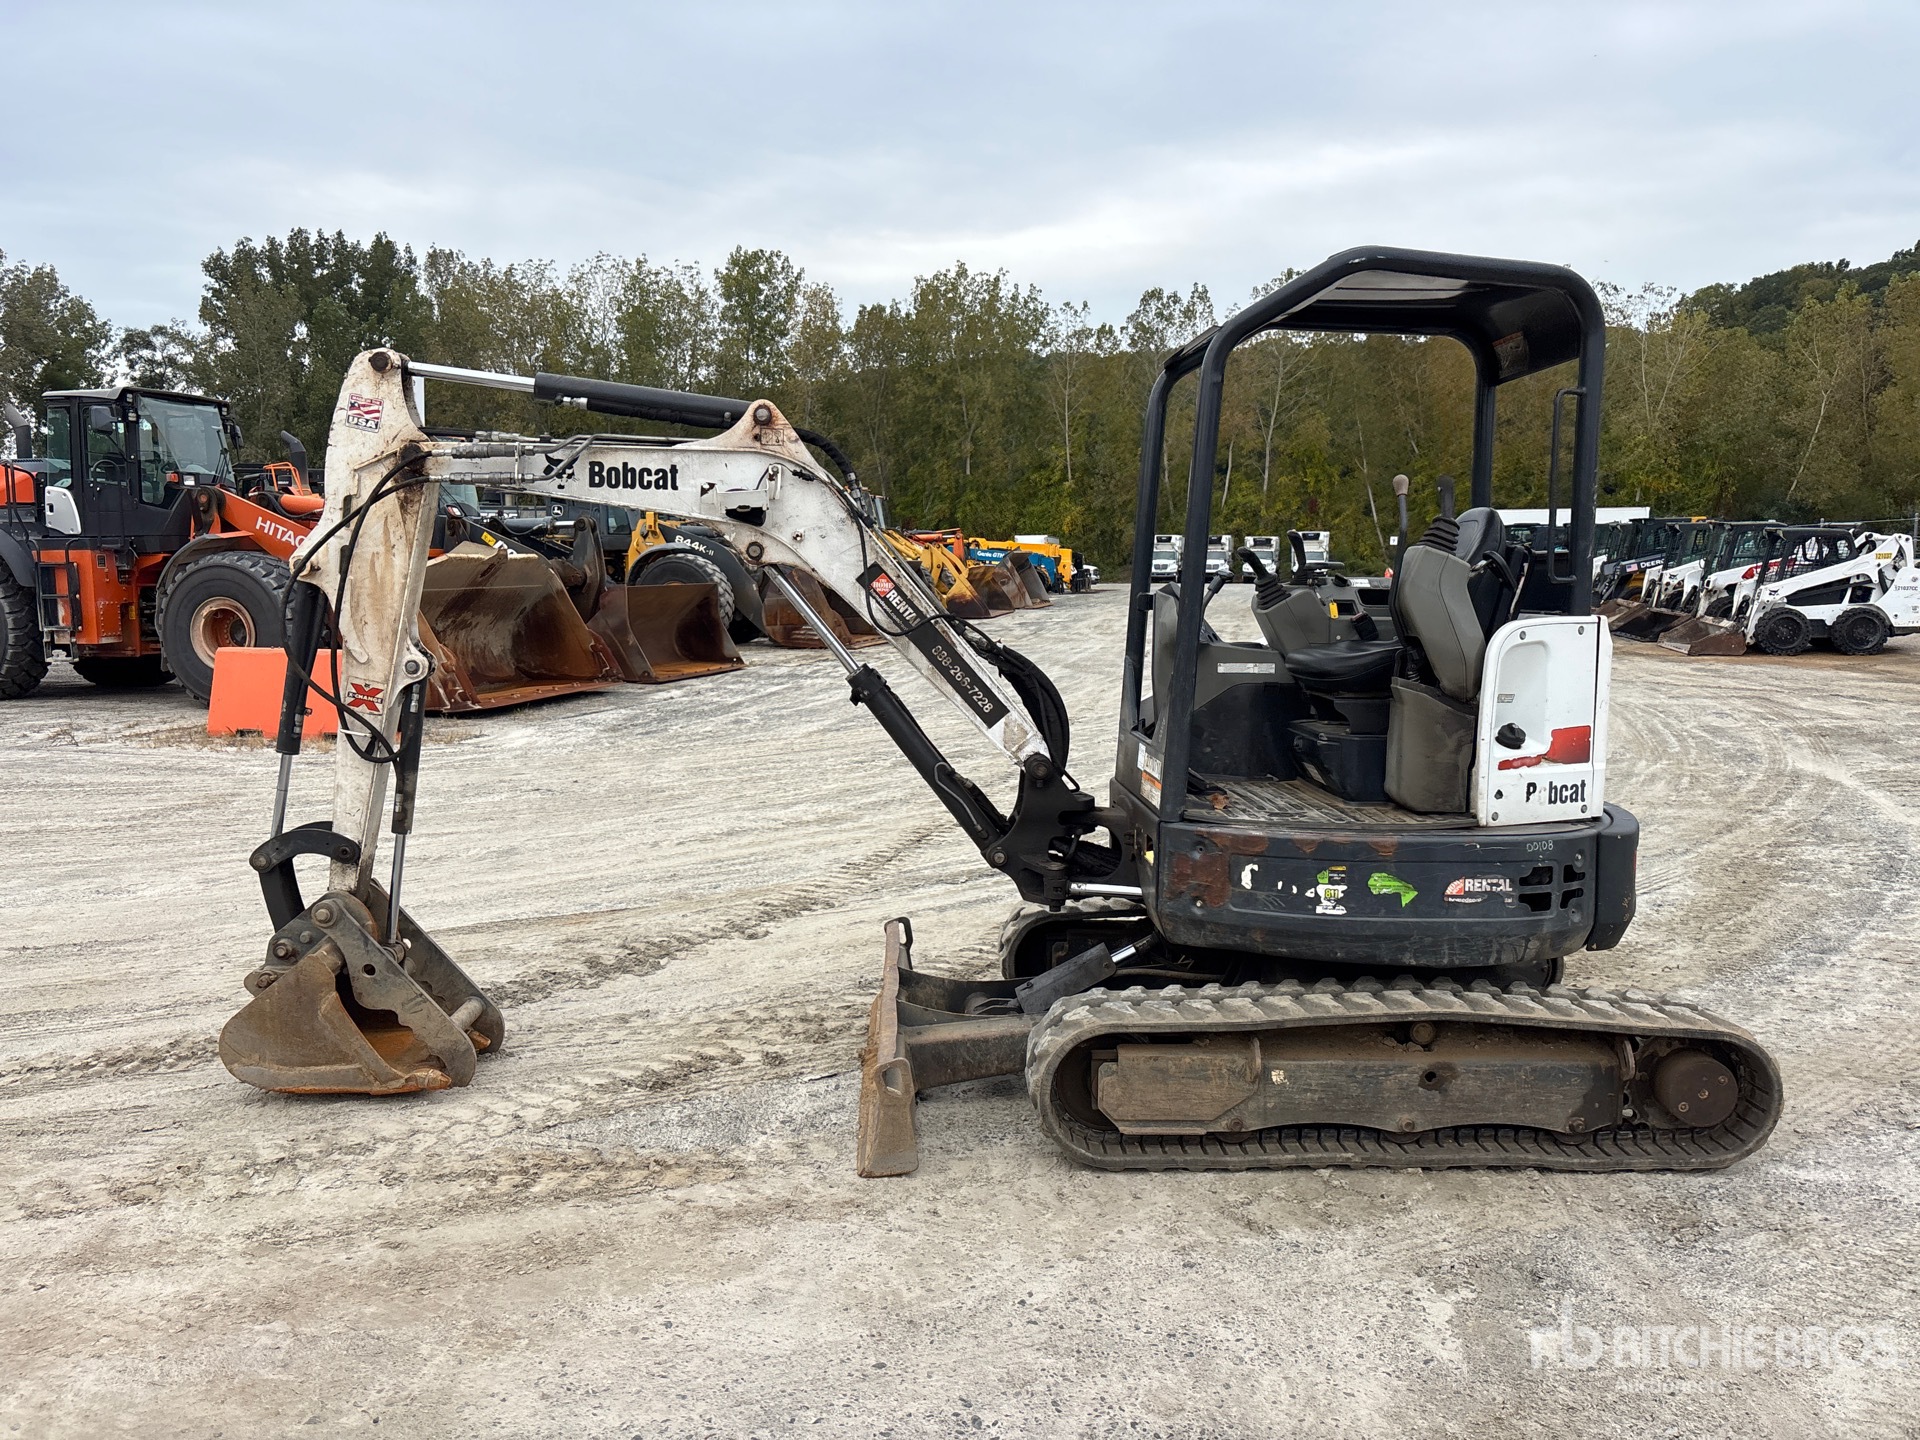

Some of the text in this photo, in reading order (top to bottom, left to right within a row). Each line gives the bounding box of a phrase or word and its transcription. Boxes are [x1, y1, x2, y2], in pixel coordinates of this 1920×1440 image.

[348, 416, 378, 429] USA
[589, 461, 679, 491] Bobcat
[256, 516, 305, 547] HITAC
[1325, 888, 1340, 899] 811
